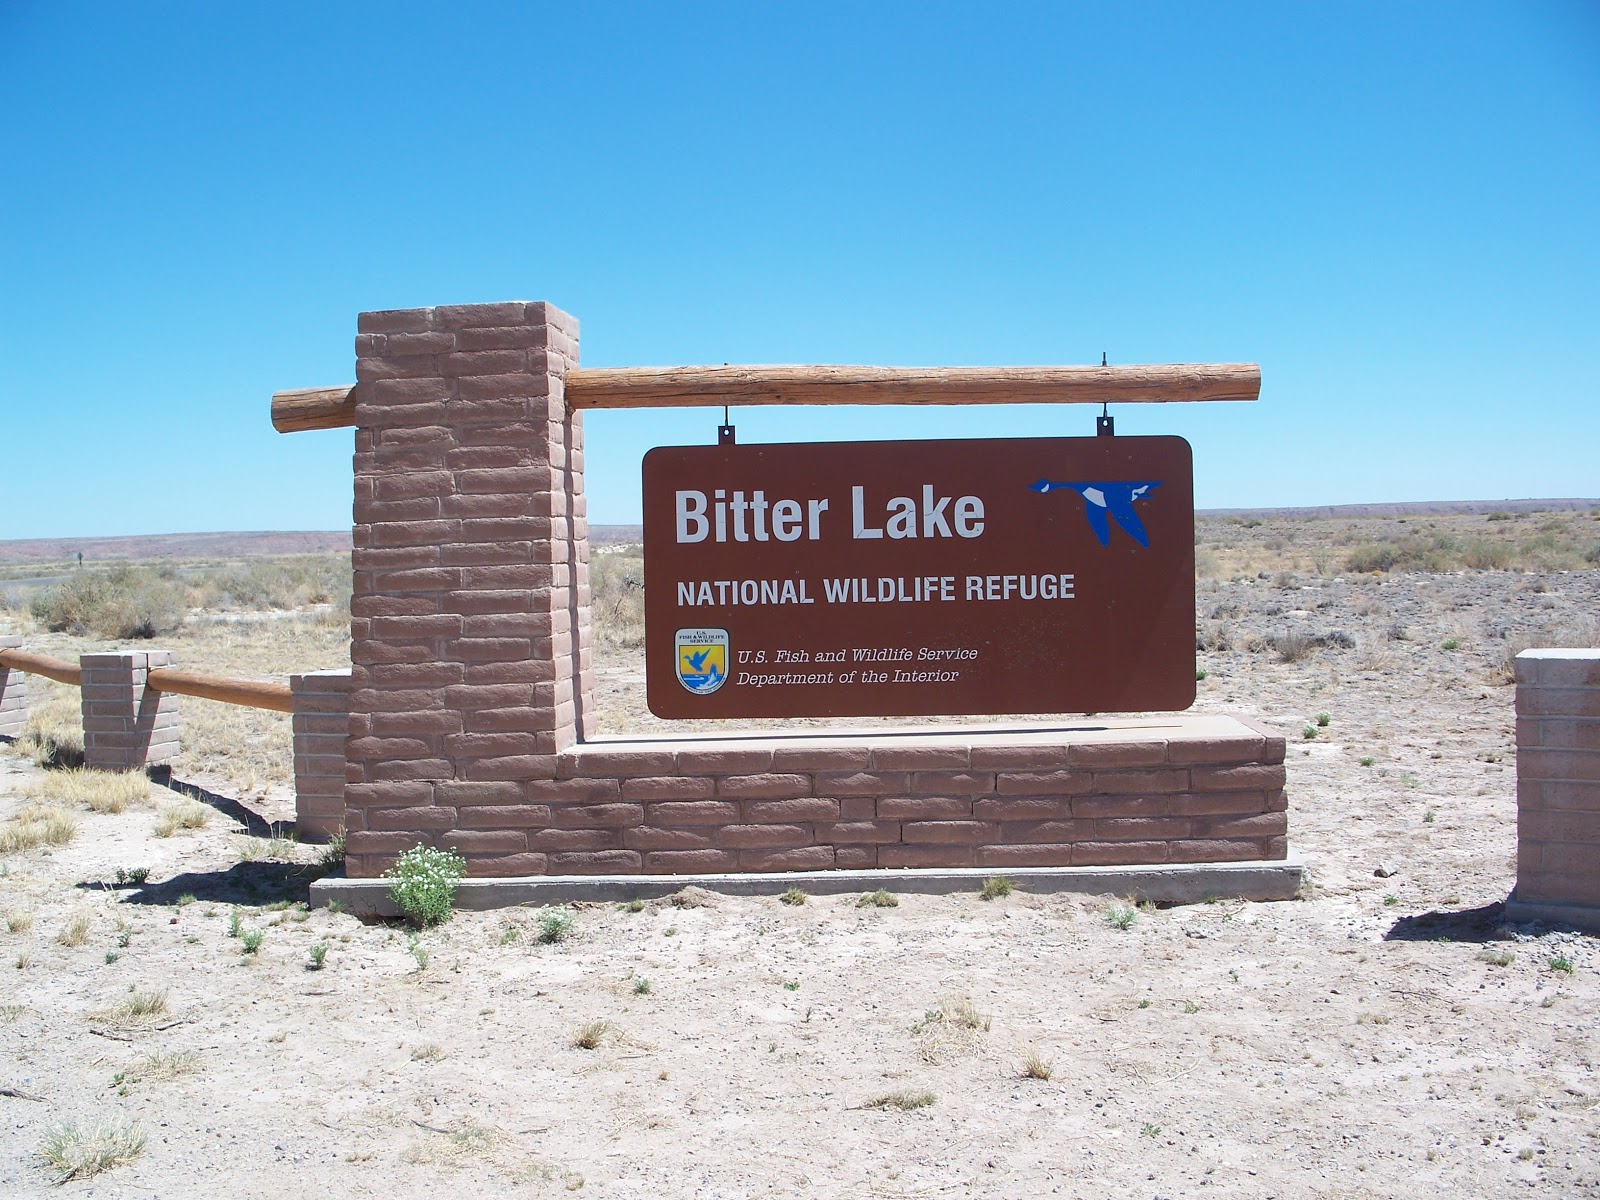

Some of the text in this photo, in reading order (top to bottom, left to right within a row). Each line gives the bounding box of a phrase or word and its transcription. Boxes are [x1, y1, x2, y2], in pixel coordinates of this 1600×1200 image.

[675, 484, 985, 544] Bitter Lake
[677, 574, 1075, 606] NATIONAL WILDLIFE REFUGE
[737, 647, 978, 664] U.S. Fish and Wildlife Service
[735, 671, 834, 688] Department
[838, 670, 858, 684] of
[861, 669, 889, 684] the
[891, 669, 960, 683] Interior
